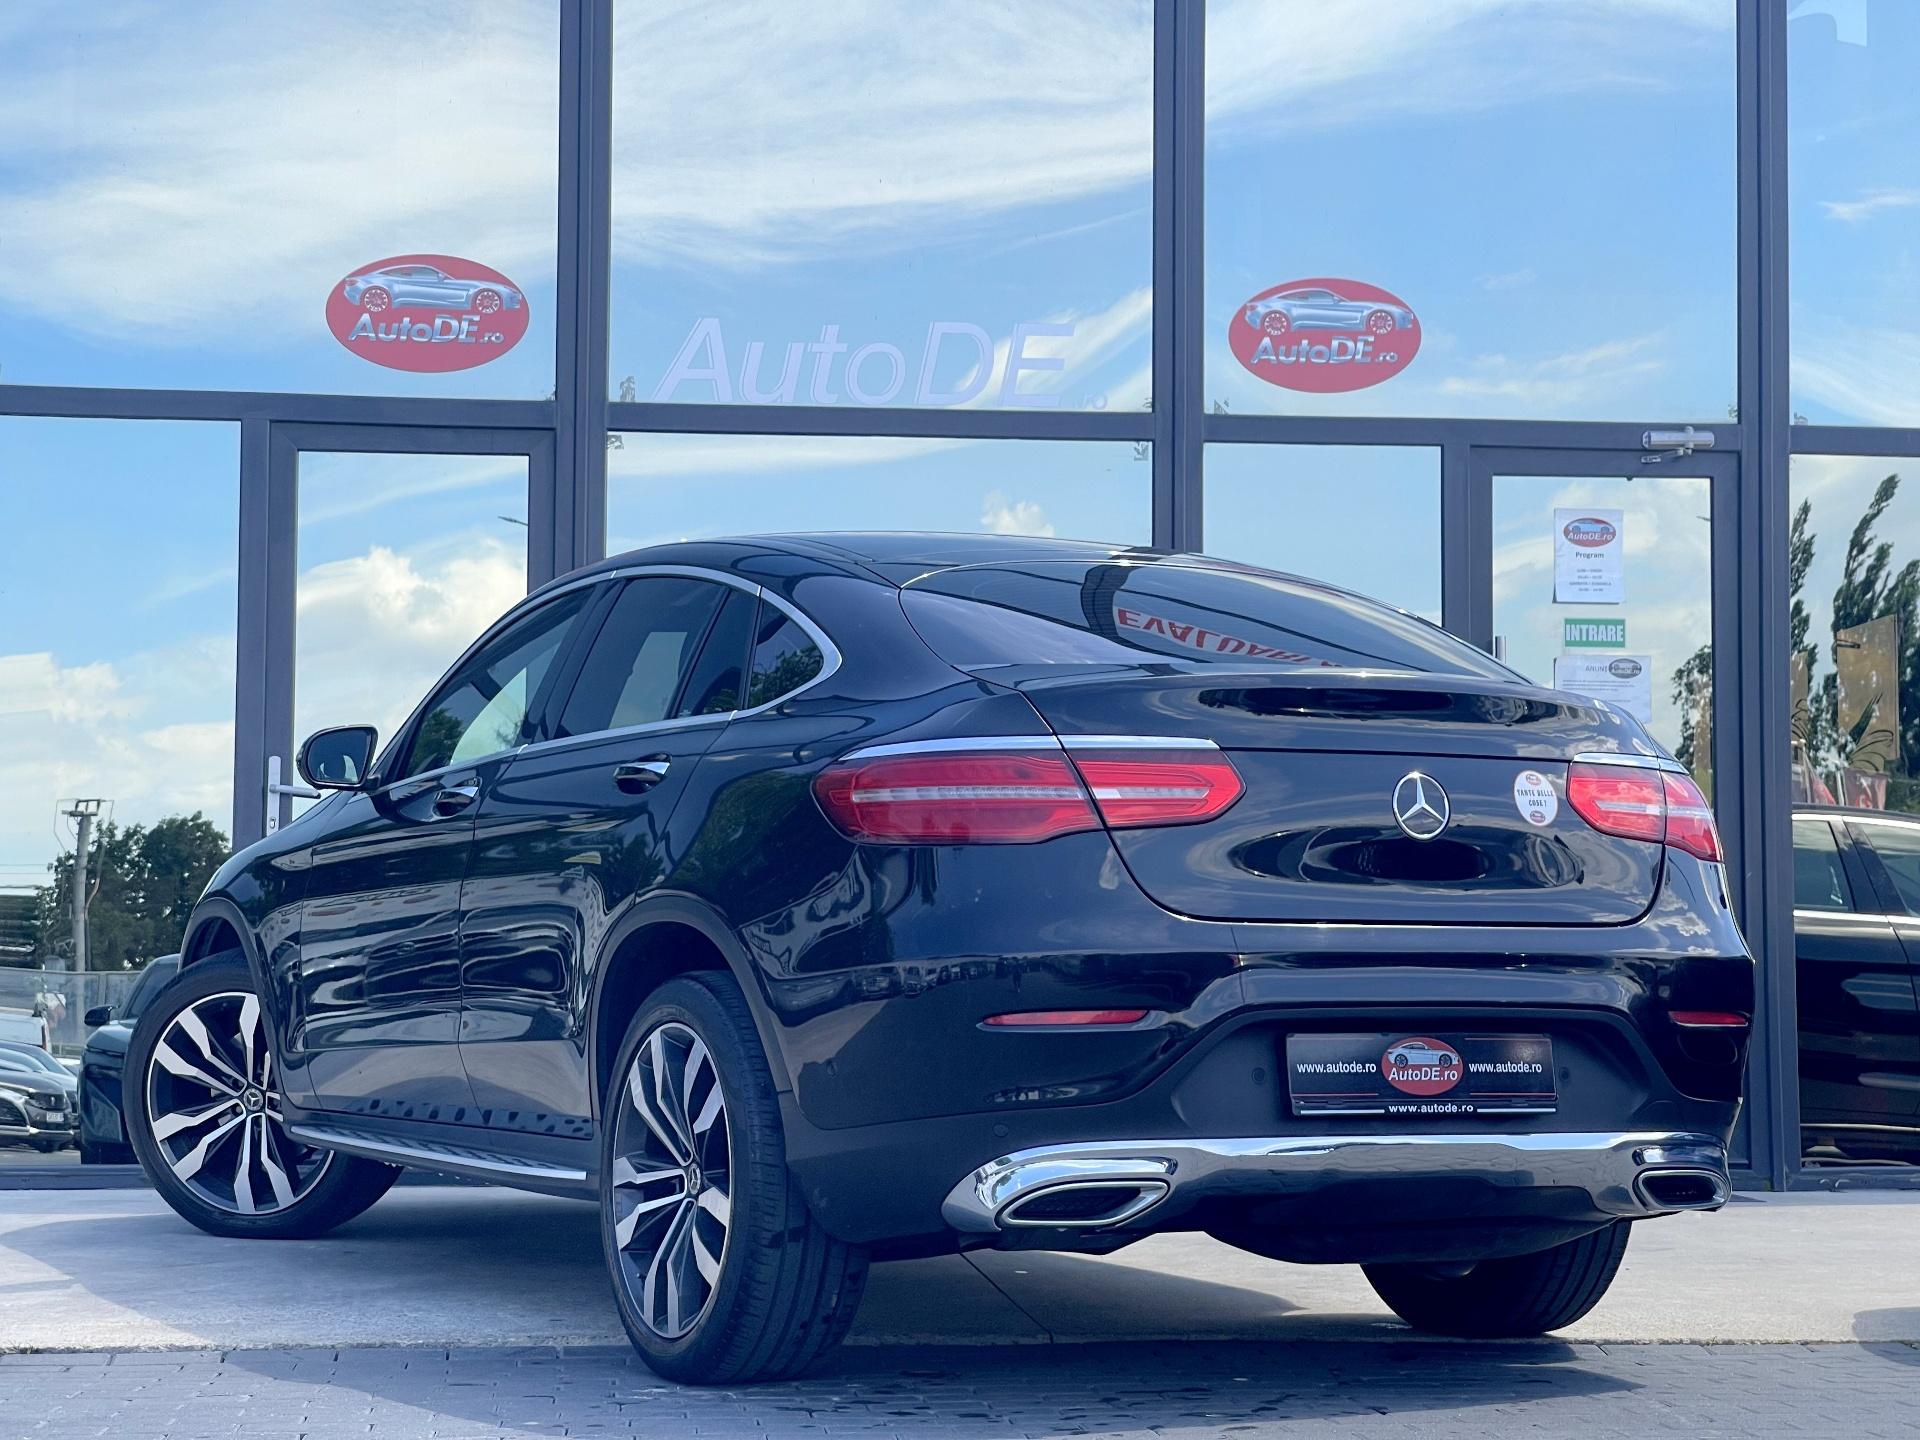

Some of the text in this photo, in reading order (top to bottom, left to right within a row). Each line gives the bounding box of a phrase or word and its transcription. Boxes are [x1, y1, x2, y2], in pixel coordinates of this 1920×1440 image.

[1575, 551, 1604, 559] Program
[1565, 624, 1624, 642] INTRARE
[1517, 789, 1535, 797] TANTE
[1297, 1061, 1377, 1073] www.autode.ro
[1469, 1061, 1543, 1073] www.autode.ro
[1388, 1067, 1458, 1081] AutoDE.ro
[1388, 1103, 1474, 1113] www.autode.ro
